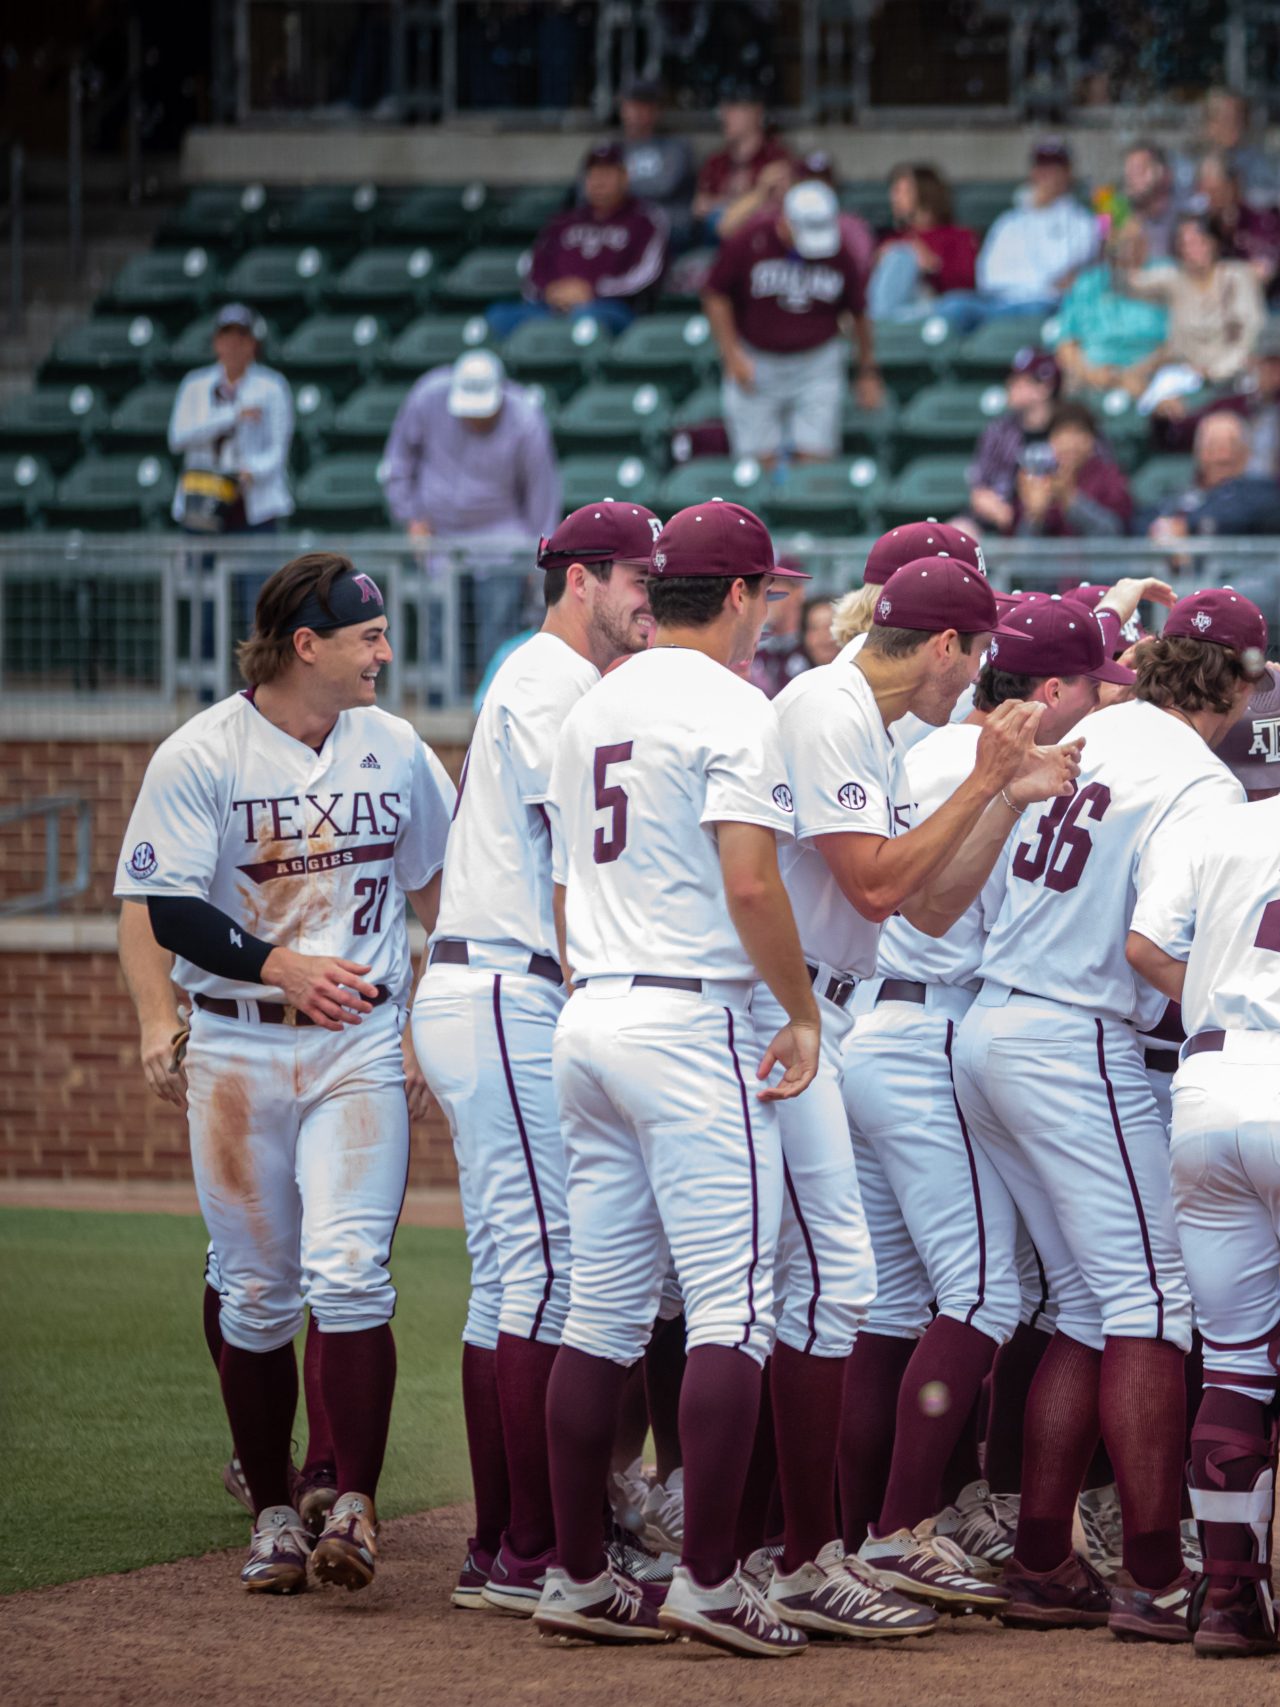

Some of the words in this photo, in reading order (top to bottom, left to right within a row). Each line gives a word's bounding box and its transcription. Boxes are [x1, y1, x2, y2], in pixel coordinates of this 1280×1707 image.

[232, 792, 401, 843] TEXAS
[593, 740, 633, 864] 5
[276, 851, 354, 874] AGGIES
[1012, 778, 1111, 893] 36
[352, 876, 390, 936] 27
